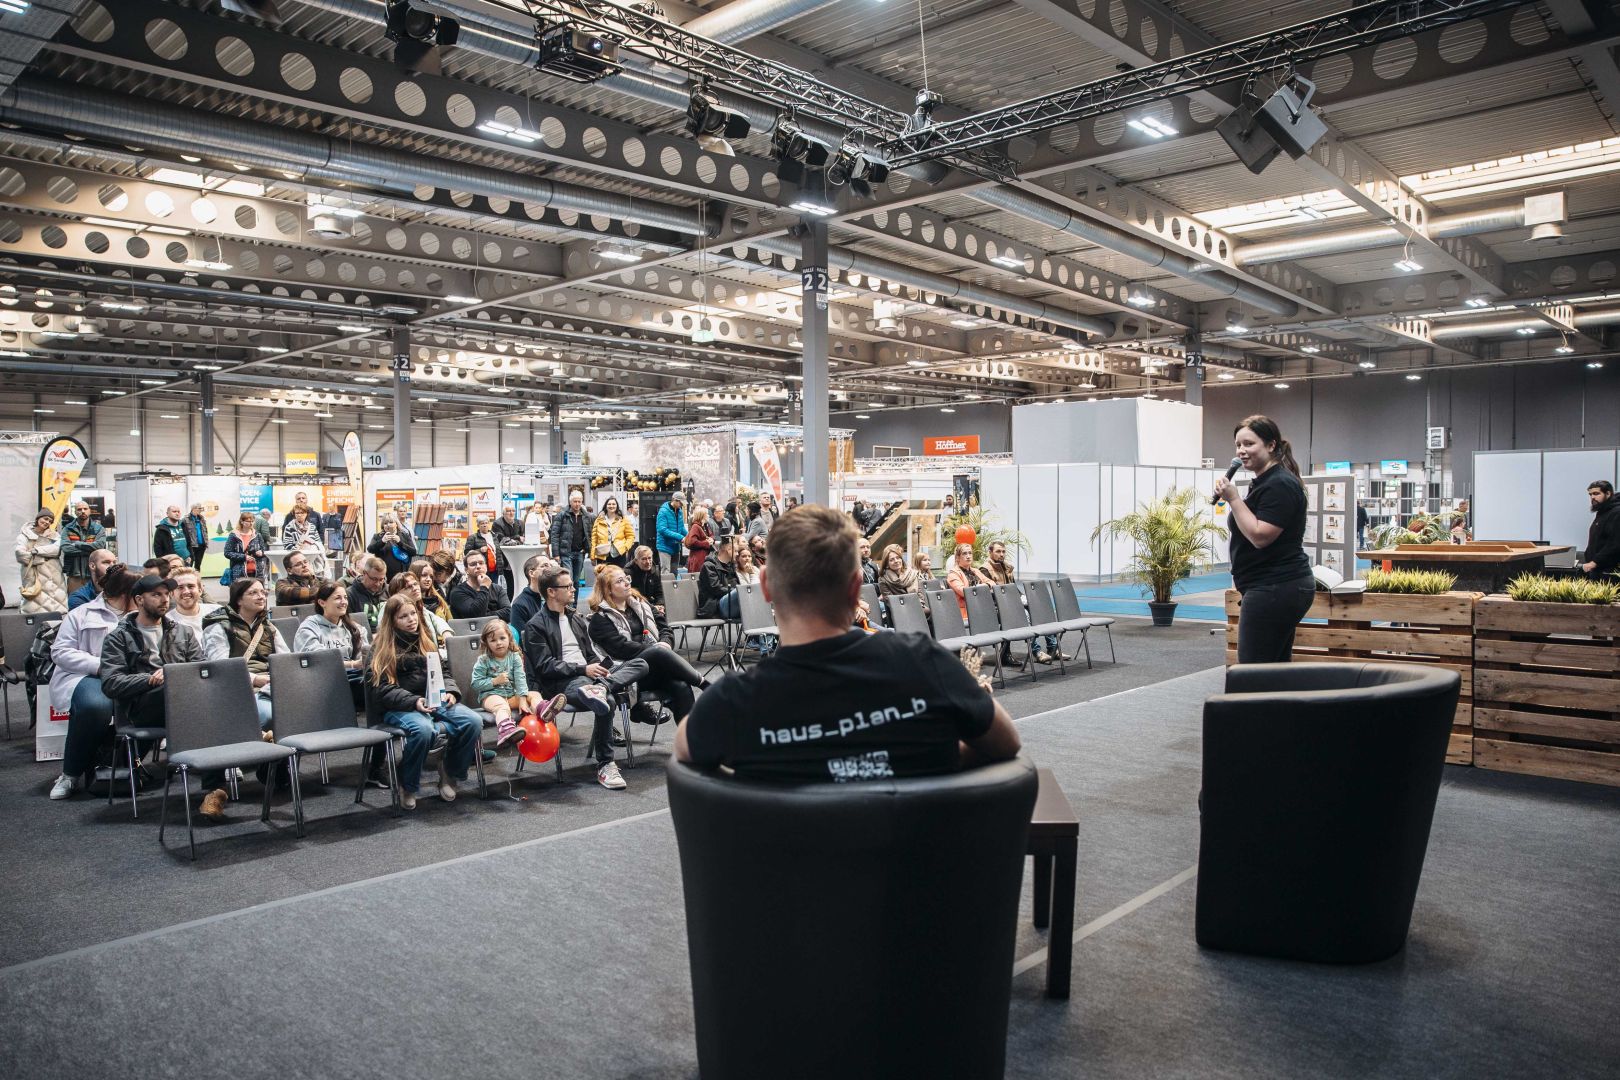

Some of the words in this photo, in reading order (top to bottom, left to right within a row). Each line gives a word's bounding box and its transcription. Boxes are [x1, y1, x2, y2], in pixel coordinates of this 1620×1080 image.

[803, 273, 814, 291] 2
[817, 273, 827, 291] 2
[400, 358, 409, 369] 2
[1187, 356, 1195, 367] 2
[788, 393, 794, 402] 2
[795, 393, 800, 402] 2
[935, 439, 967, 450] Höffner
[369, 455, 382, 466] 10
[760, 696, 927, 745] haus_plan_b
